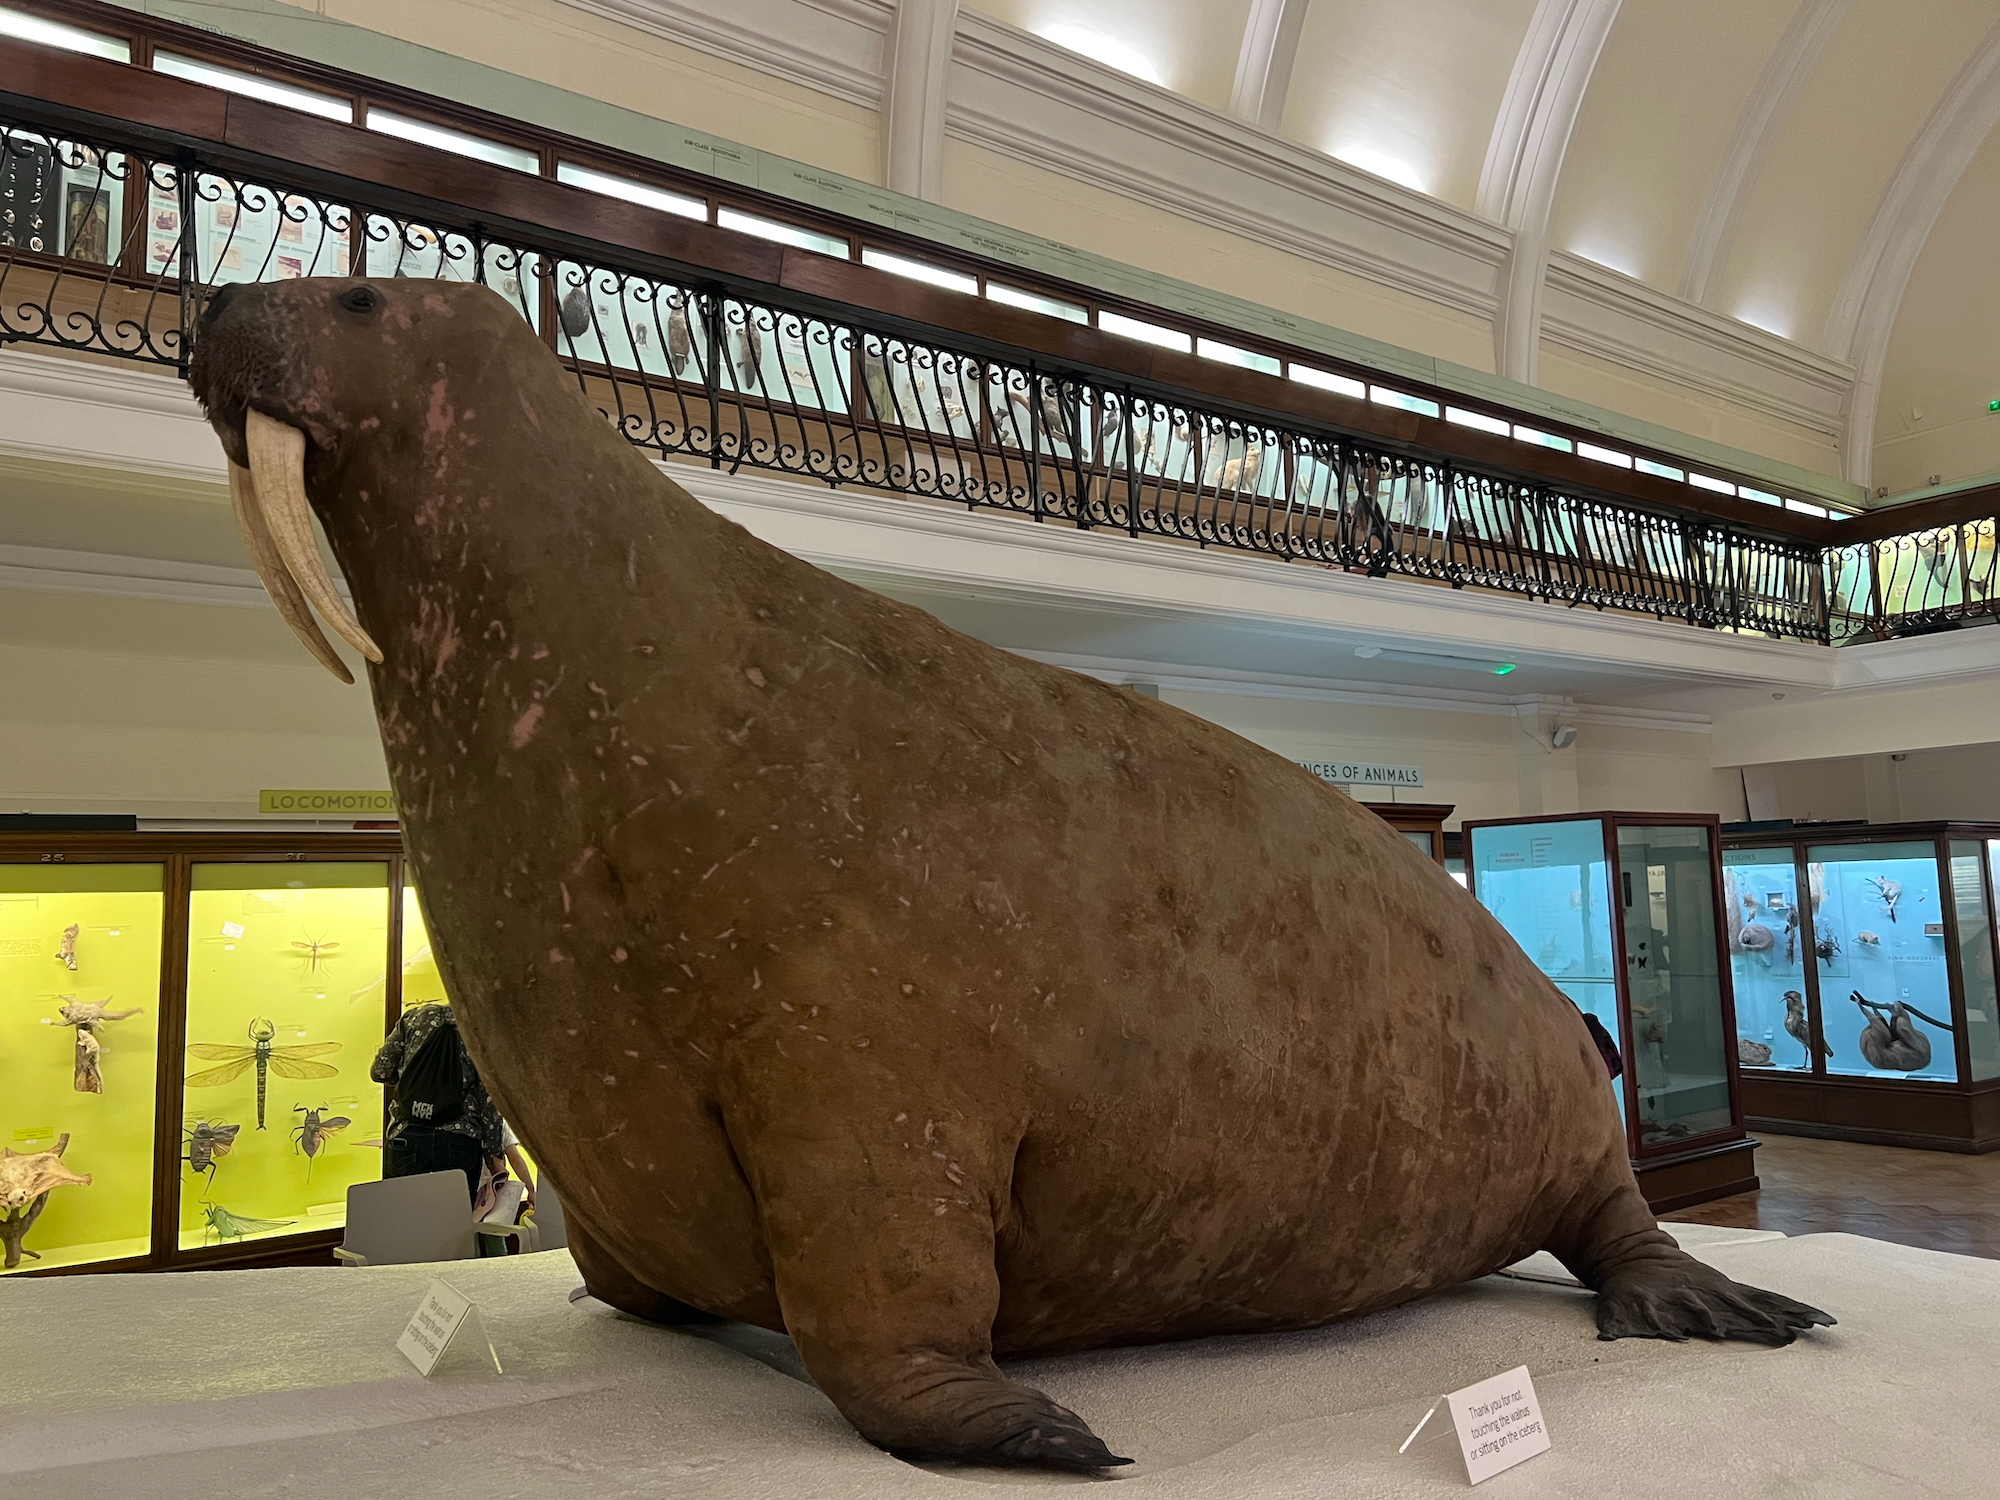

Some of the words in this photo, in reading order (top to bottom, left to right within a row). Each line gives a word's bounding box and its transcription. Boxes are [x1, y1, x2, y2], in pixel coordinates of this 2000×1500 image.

[1294, 763, 1337, 778] NCES
[1342, 765, 1359, 779] OF
[1364, 767, 1418, 783] ANIMALS
[41, 853, 65, 862] 25
[1468, 1402, 1490, 1420] Thank
[1489, 1399, 1502, 1415] you
[1501, 1394, 1510, 1406] for
[1511, 1389, 1523, 1402] not
[1471, 1421, 1500, 1440] touching
[1498, 1414, 1510, 1427] the
[1510, 1406, 1530, 1422] walrus
[1470, 1449, 1478, 1461] or
[1478, 1440, 1500, 1457] sitting
[1499, 1436, 1508, 1447] on
[1507, 1431, 1519, 1443] the
[1517, 1421, 1542, 1438] iceberg
